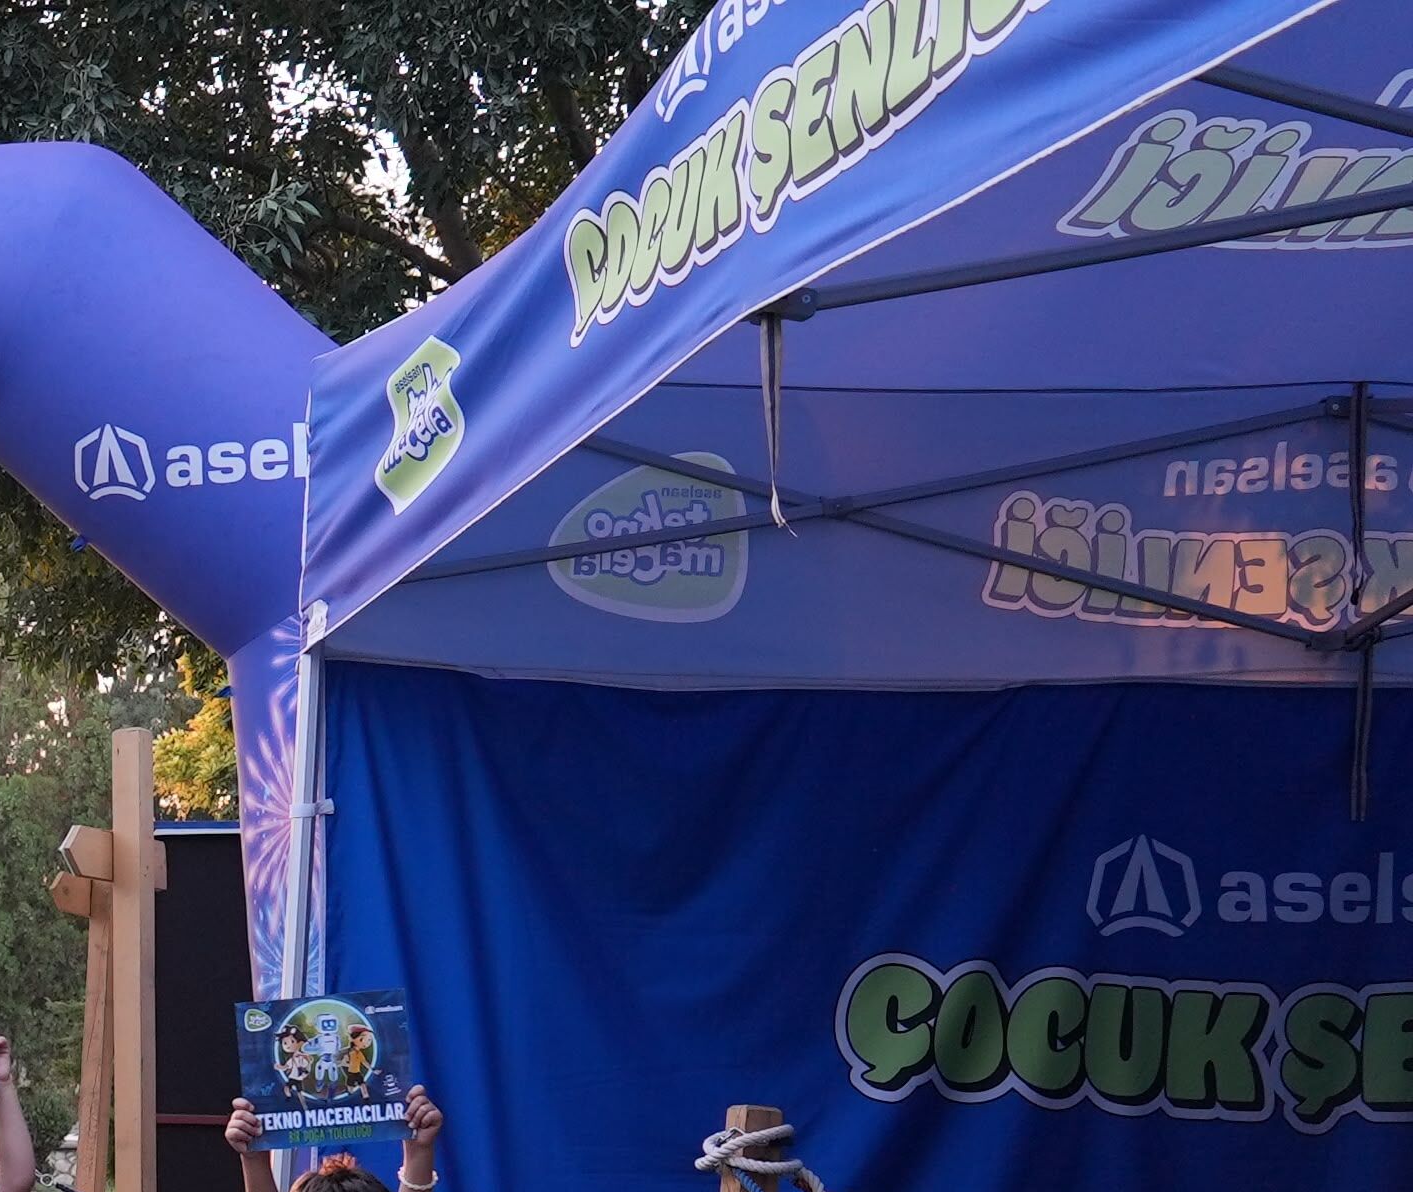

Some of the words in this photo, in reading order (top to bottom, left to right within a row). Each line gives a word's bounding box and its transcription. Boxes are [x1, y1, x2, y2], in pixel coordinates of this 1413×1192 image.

[395, 364, 422, 393] aselsan
[1217, 852, 1413, 925] asel
[842, 958, 1270, 1114] ÇOCUK
[257, 1111, 302, 1132] TEKNO
[305, 1102, 406, 1127] MACERACILAR
